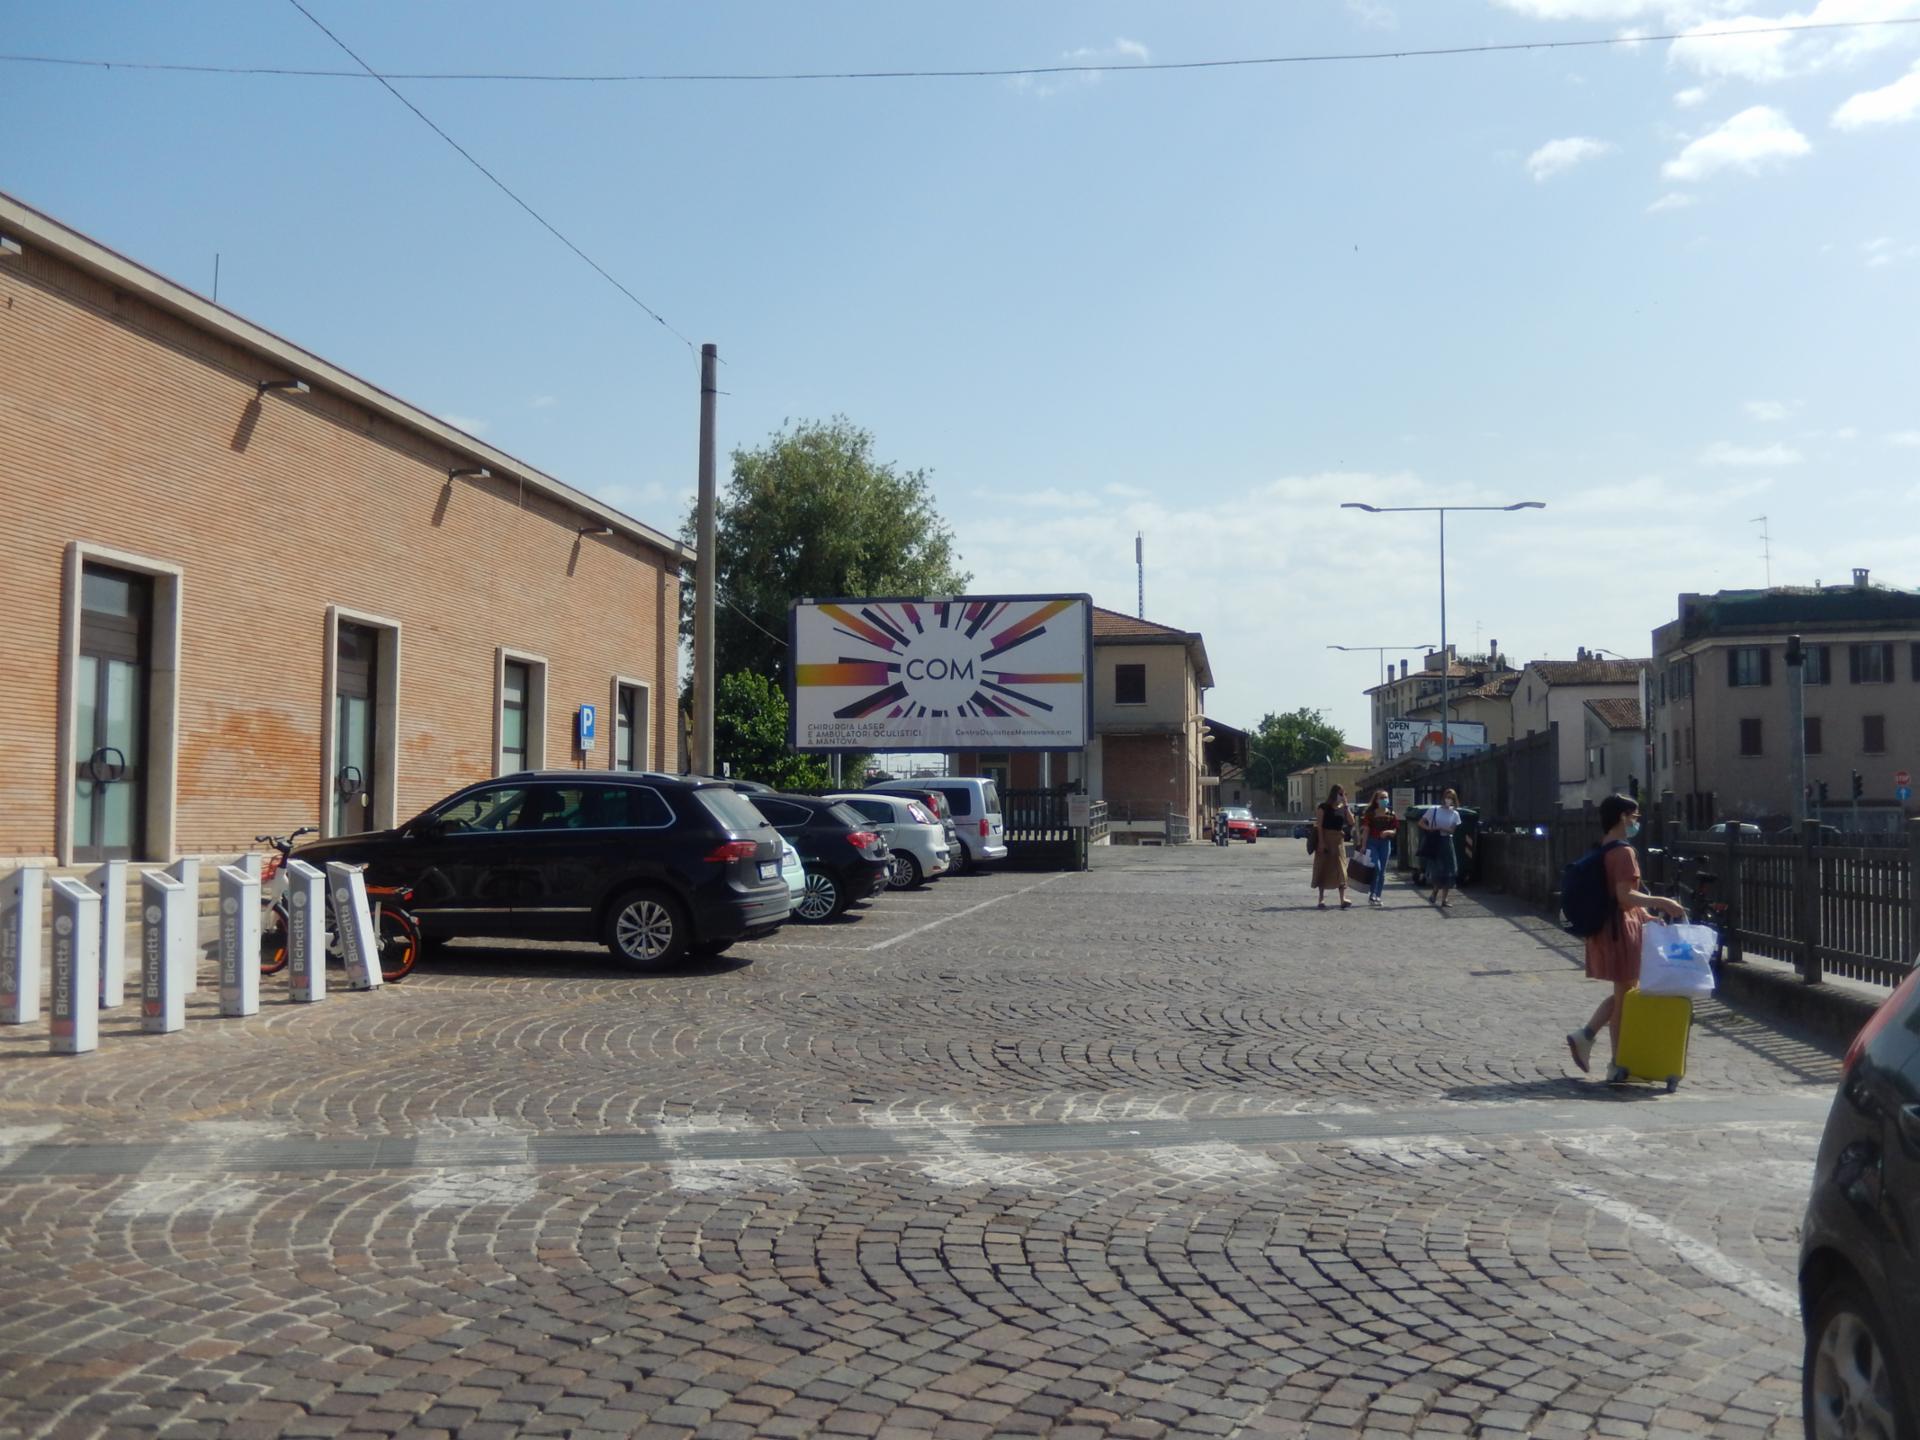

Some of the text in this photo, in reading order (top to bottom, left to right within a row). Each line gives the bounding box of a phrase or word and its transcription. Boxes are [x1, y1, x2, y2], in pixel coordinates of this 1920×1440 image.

[906, 658, 974, 680] COM
[583, 707, 593, 735] P
[807, 722, 885, 731] CHIRURGIA LASER
[1388, 722, 1410, 730] OPEN
[815, 730, 871, 738] AMBULATORI
[873, 729, 922, 737] OCULISTICI
[1388, 731, 1404, 740] DAY
